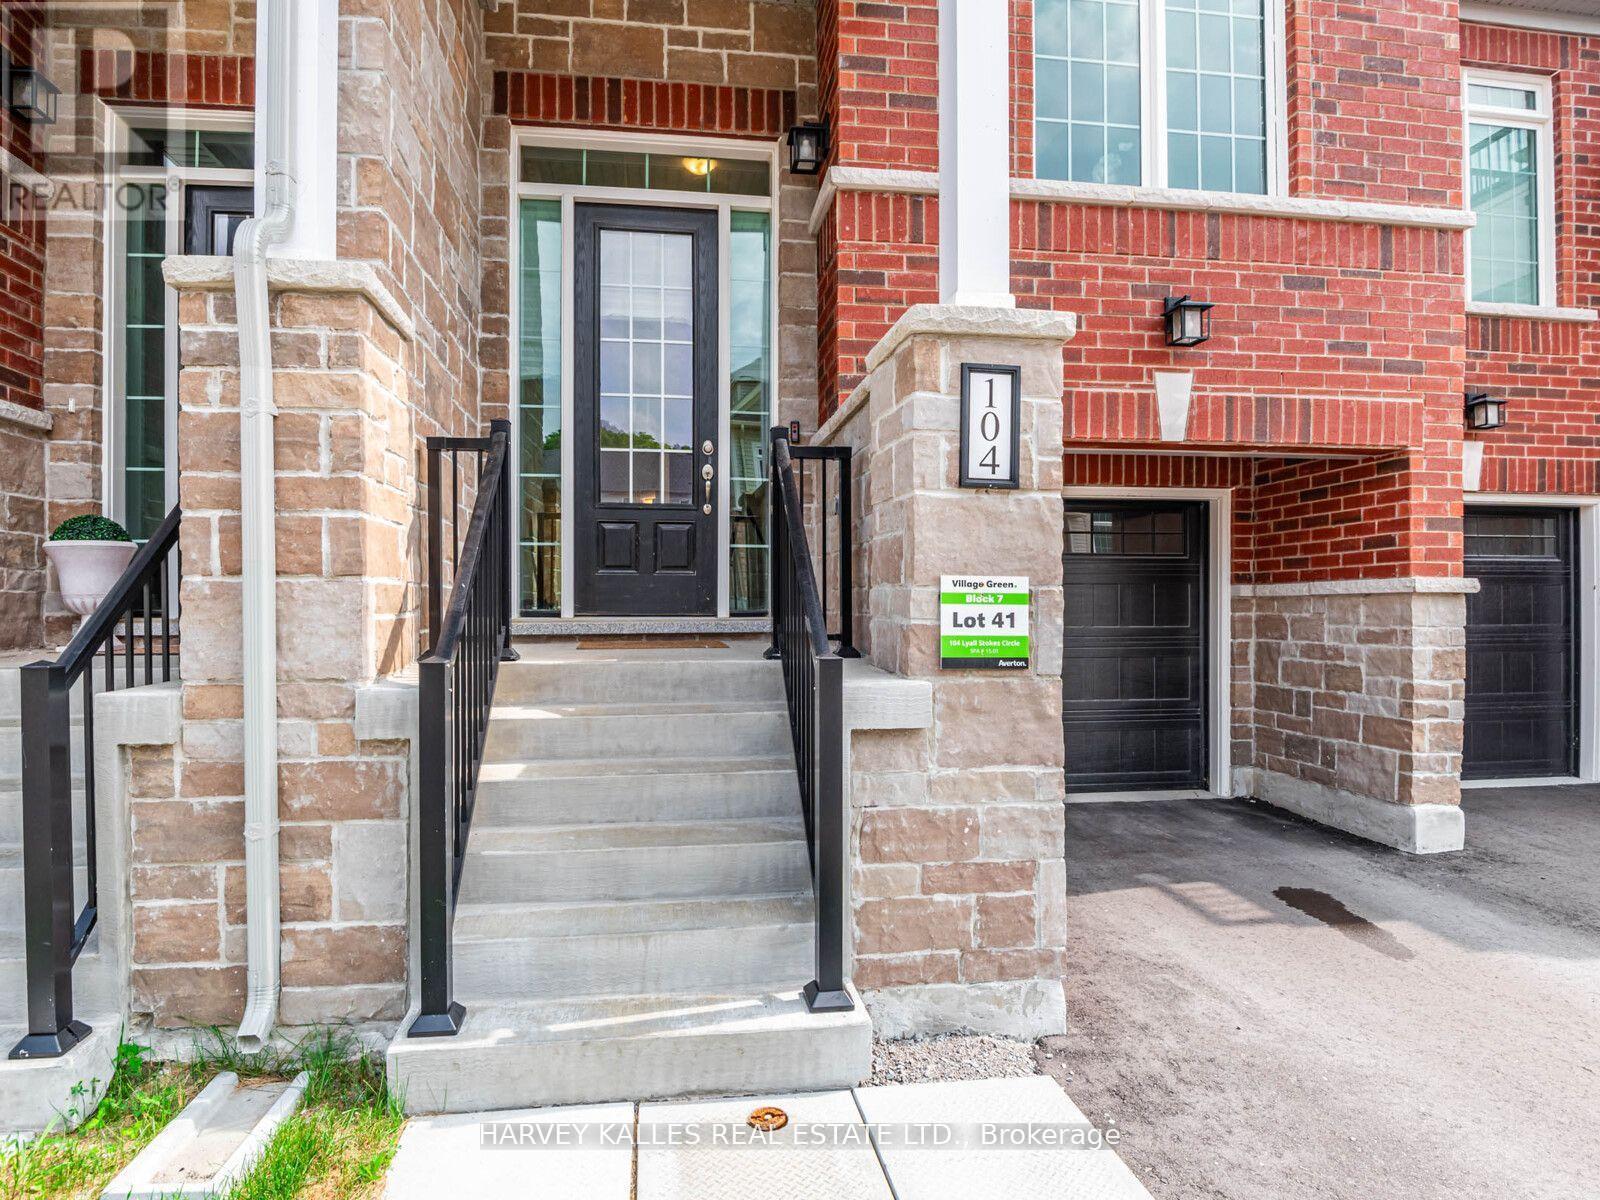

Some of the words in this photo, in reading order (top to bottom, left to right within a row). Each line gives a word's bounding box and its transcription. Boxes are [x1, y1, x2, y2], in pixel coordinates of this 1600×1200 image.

[979, 378, 1000, 475] 104
[952, 579, 984, 590] Village
[965, 594, 994, 604] Block
[996, 594, 1004, 604] 7
[952, 612, 986, 628] Lot
[991, 612, 1015, 628] 41
[949, 639, 961, 647] 104
